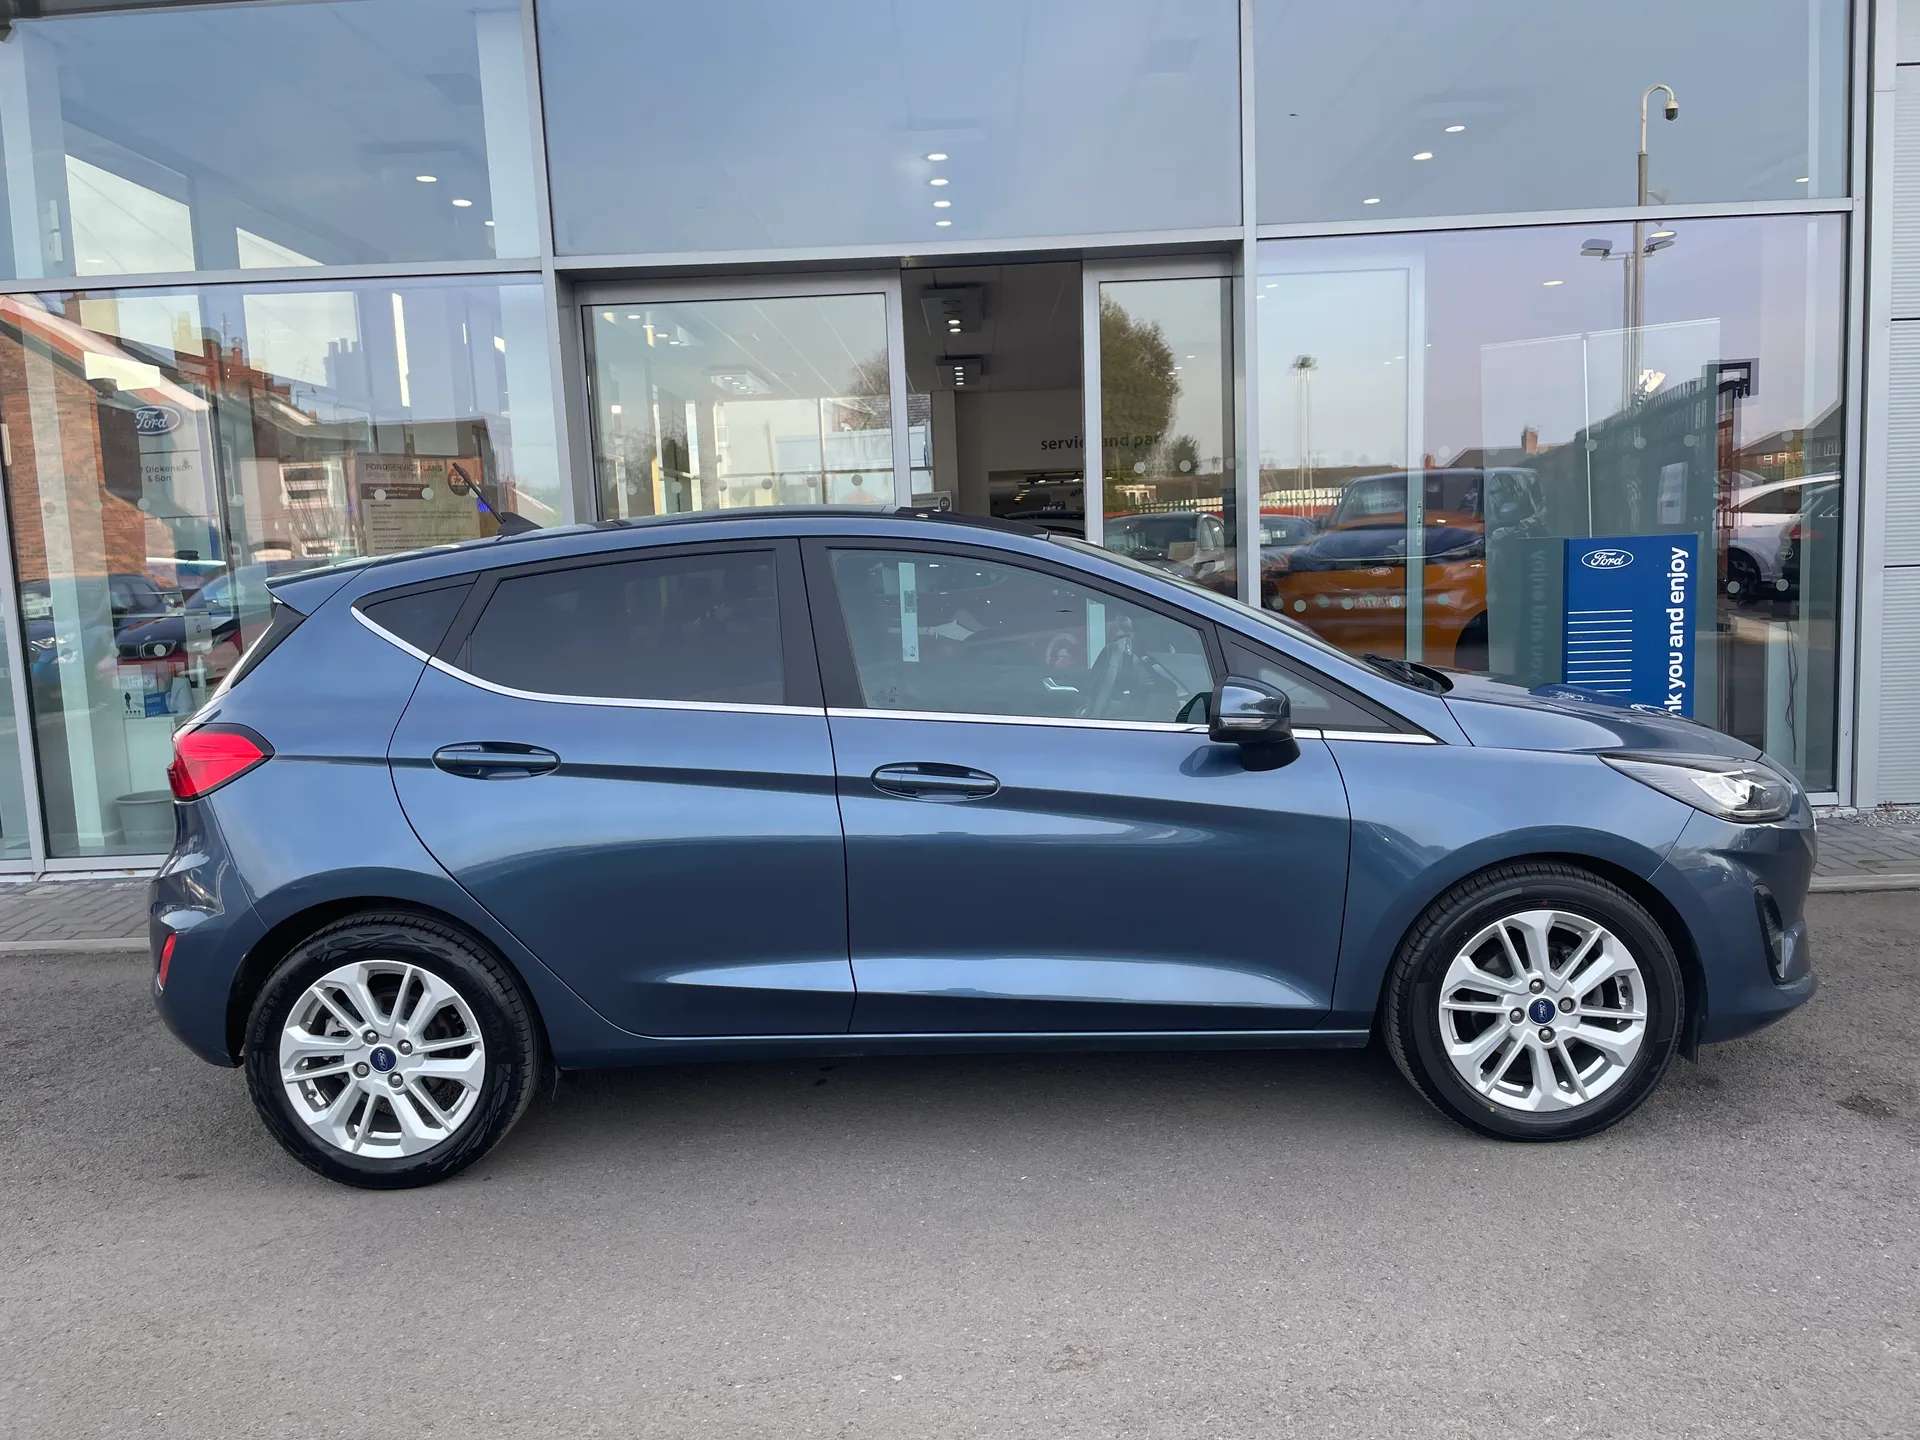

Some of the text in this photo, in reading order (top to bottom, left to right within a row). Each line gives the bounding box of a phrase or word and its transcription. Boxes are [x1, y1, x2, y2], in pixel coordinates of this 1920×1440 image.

[136, 410, 168, 429] Ford
[1041, 435, 1084, 450] servic
[1134, 432, 1160, 448] par
[1590, 551, 1625, 566] Ford
[1666, 547, 1688, 604] enjoy
[1666, 607, 1684, 648] and
[1668, 652, 1686, 688] you
